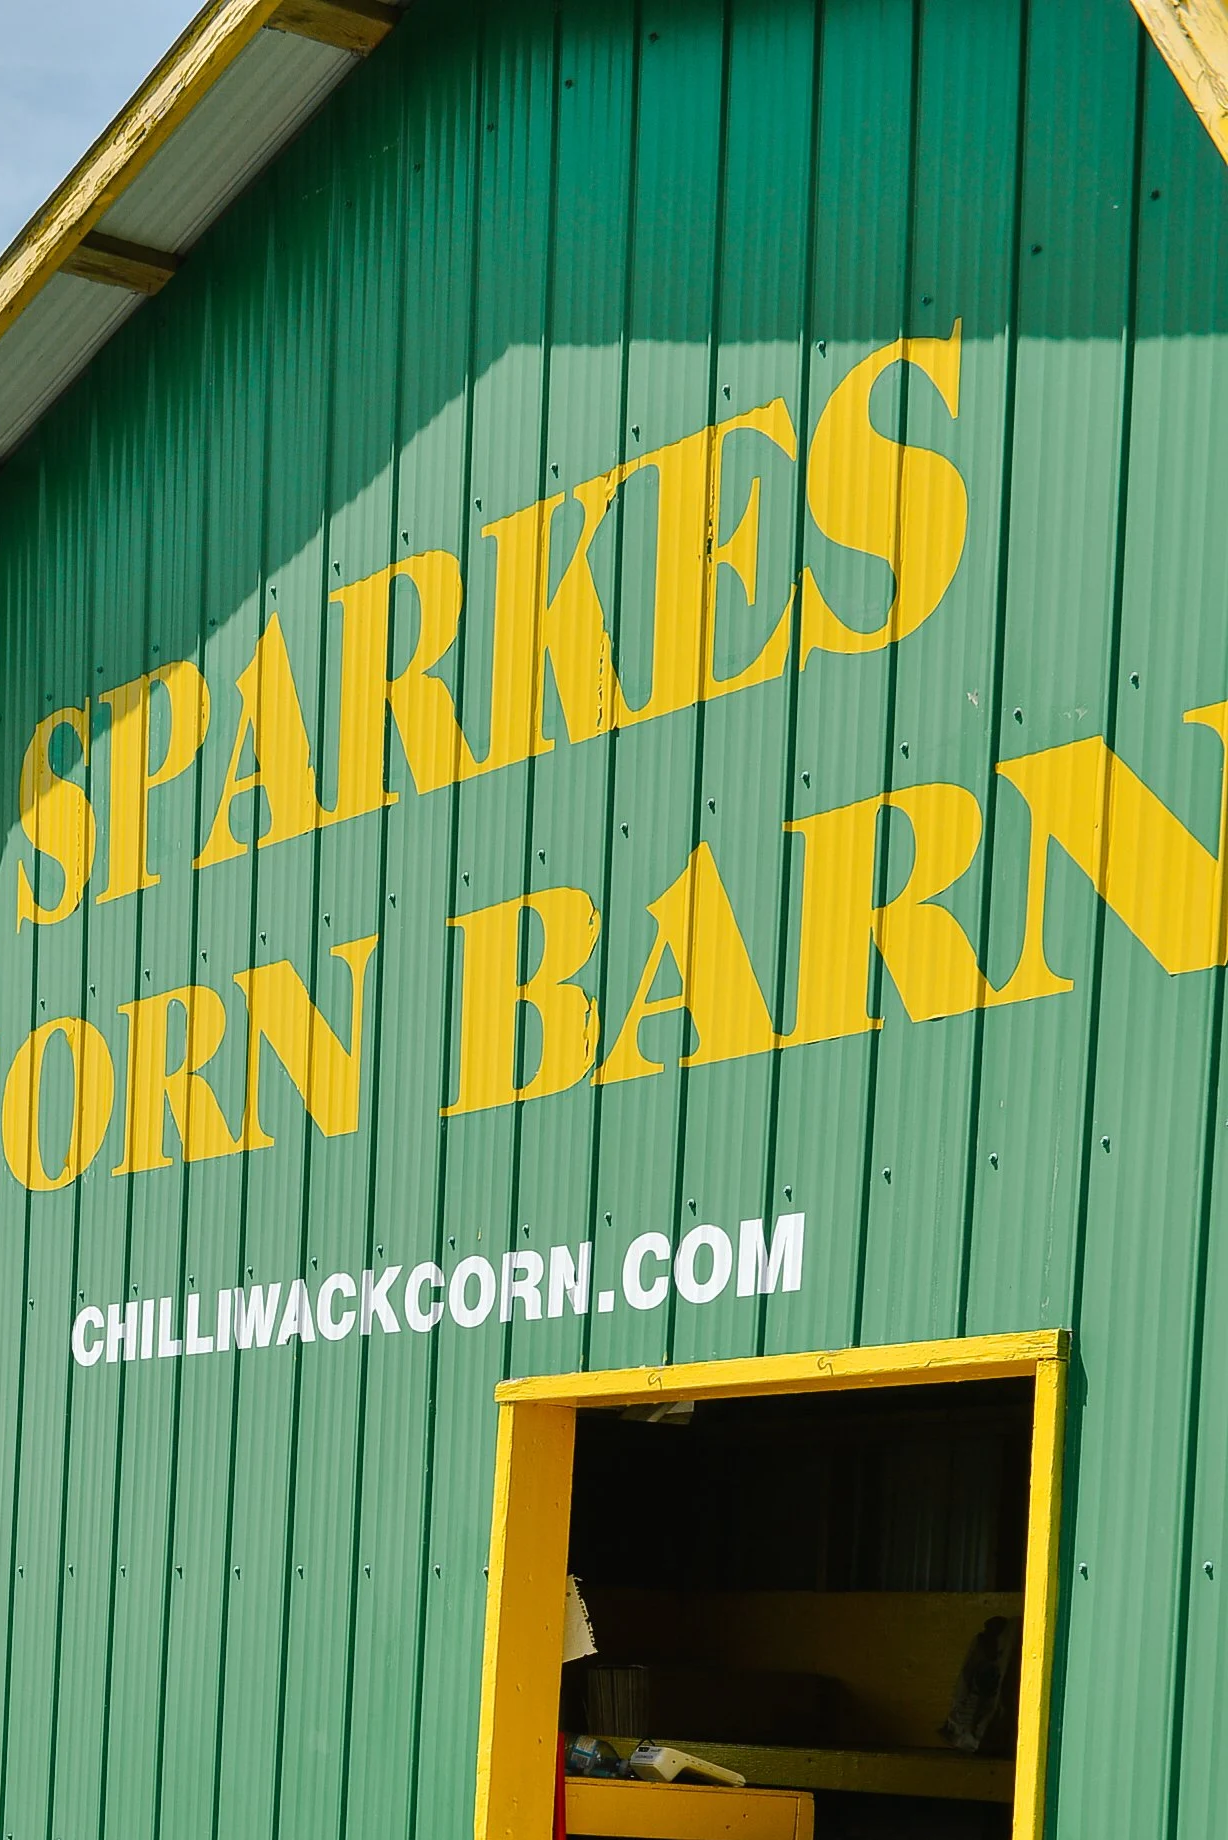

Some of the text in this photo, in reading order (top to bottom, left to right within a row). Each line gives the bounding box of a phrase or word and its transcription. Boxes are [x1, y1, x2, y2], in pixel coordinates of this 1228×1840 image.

[16, 318, 969, 933] SPARKES
[440, 700, 1228, 1118] BARN
[71, 1212, 807, 1368] CHILLIWACKCORN.COM
